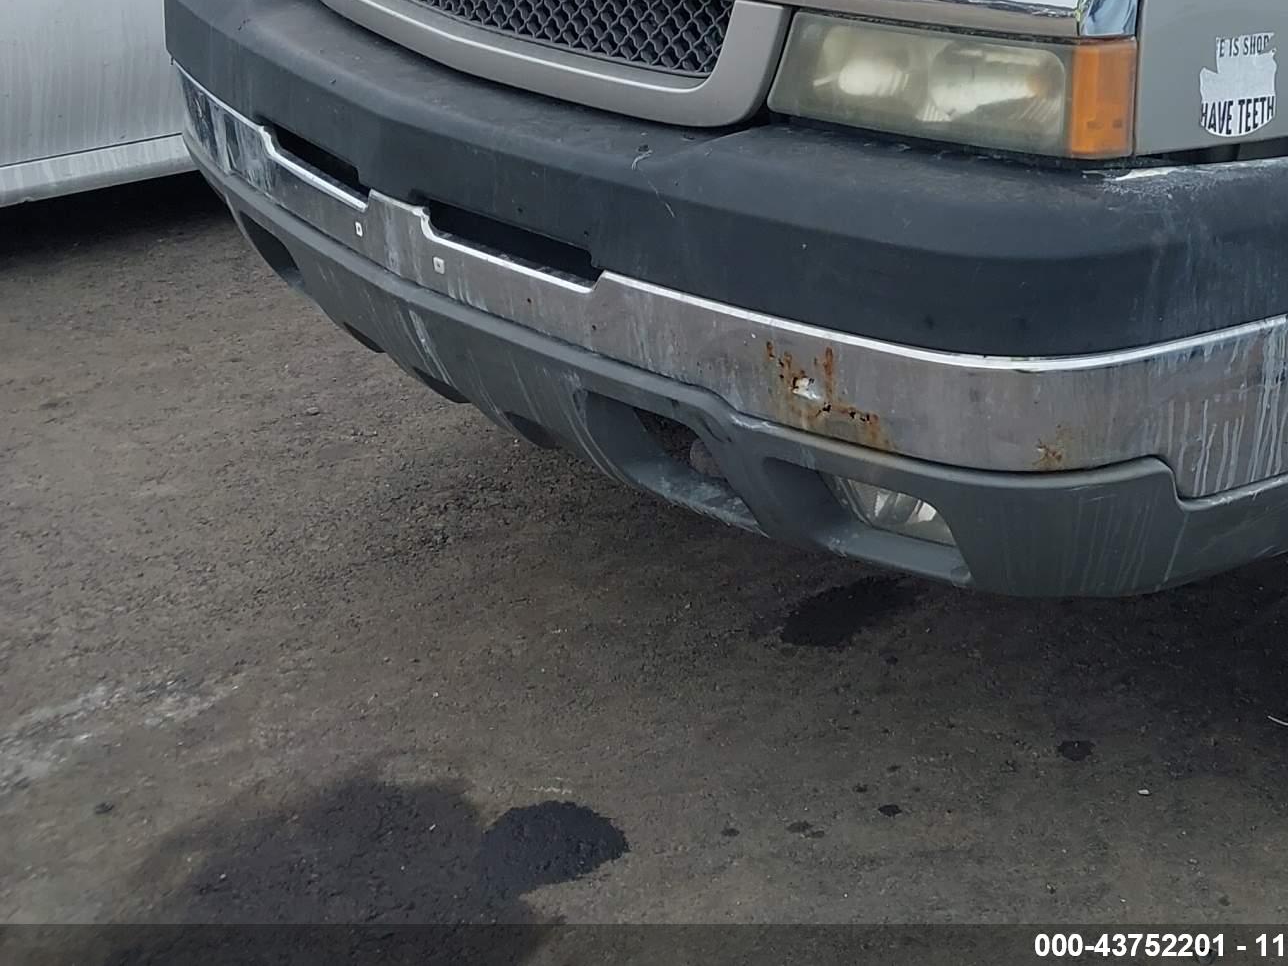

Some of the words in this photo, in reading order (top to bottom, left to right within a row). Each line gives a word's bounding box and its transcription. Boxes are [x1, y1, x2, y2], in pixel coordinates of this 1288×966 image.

[1229, 38, 1240, 57] IS
[1200, 99, 1234, 136] HAVE
[1238, 95, 1275, 135] TEETH
